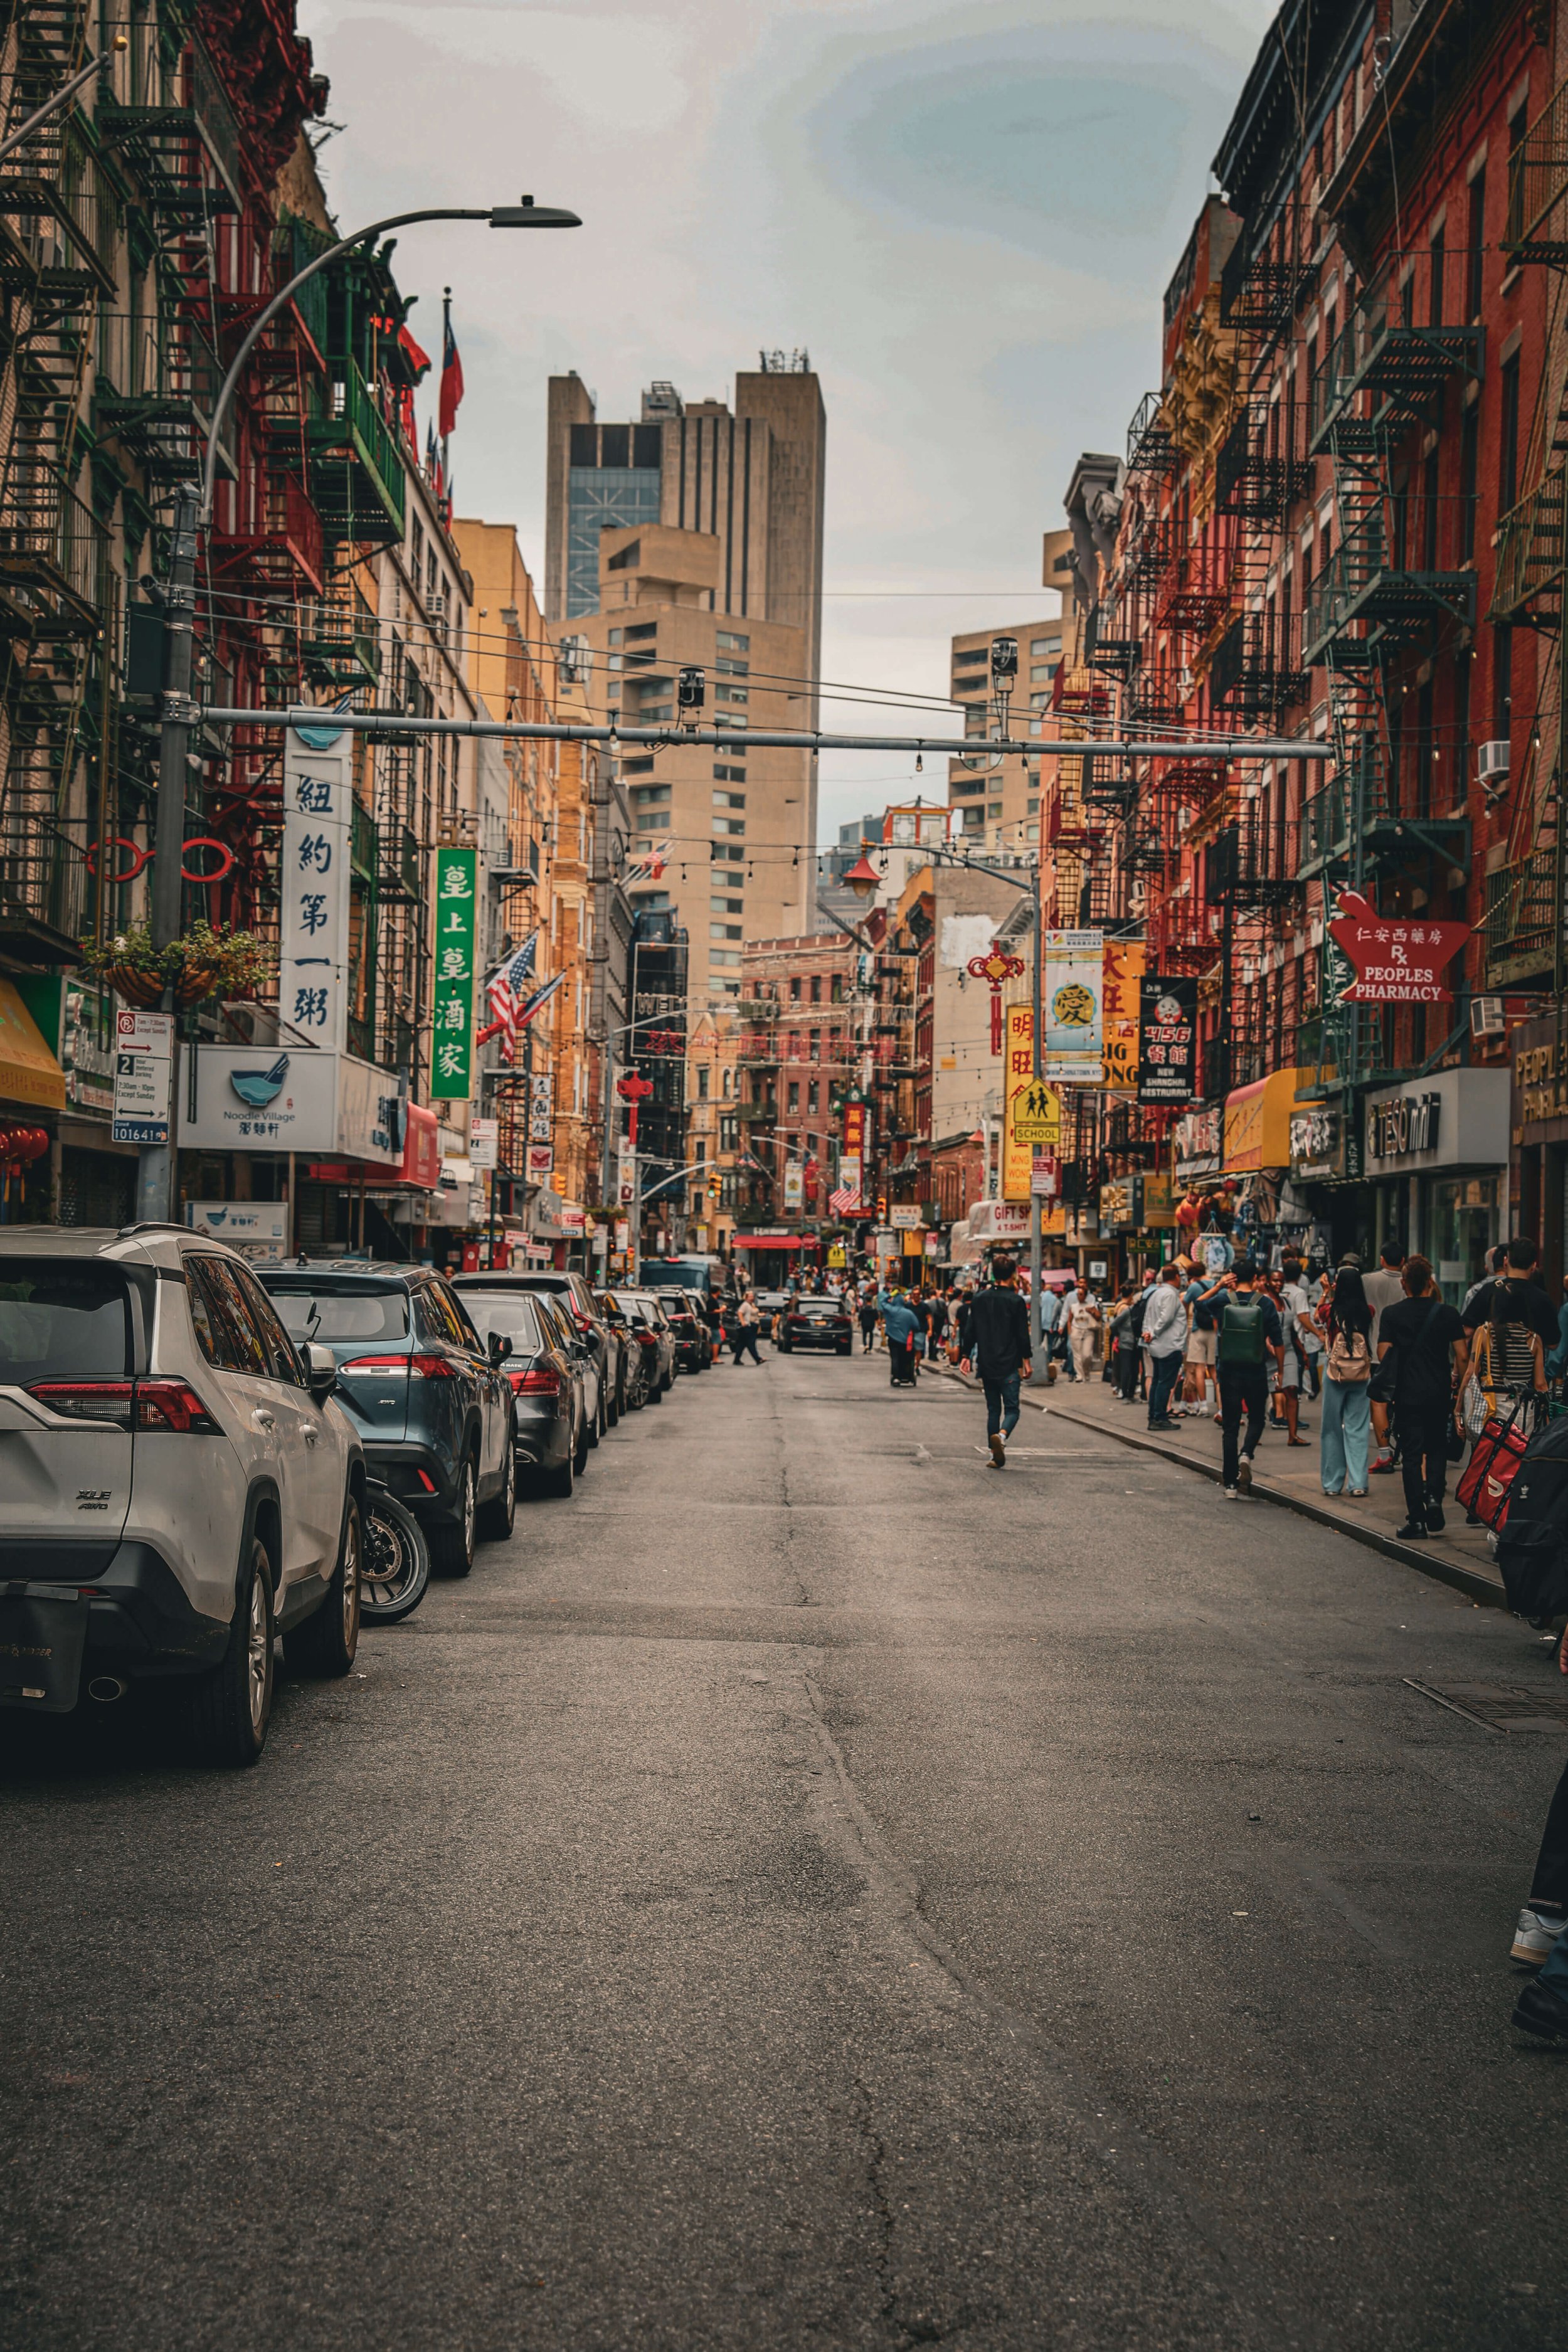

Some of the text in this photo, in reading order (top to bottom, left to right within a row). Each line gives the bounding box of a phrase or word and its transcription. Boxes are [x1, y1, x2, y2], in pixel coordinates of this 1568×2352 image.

[295, 776, 334, 1027] 紐約第一粥
[1357, 927, 1443, 945] 仁安西藥房
[1365, 967, 1433, 983] PEOPLES
[1355, 984, 1441, 1001] PHARMACY
[1058, 984, 1091, 1024] 愛
[1145, 1027, 1191, 1042] 456
[120, 1056, 130, 1074] 2
[1157, 1068, 1175, 1078] NEW
[1146, 1078, 1186, 1087] SHANGHAI
[118, 1090, 155, 1101] Except Sunday
[1140, 1088, 1192, 1097] RESTAURANT
[224, 1111, 295, 1123] Noodle Village
[115, 1128, 154, 1141] 101641
[1017, 1130, 1057, 1139] SCHOOL
[1010, 1155, 1029, 1165] MING
[995, 1205, 1017, 1220] GIFT
[76, 1490, 112, 1500] XLE
